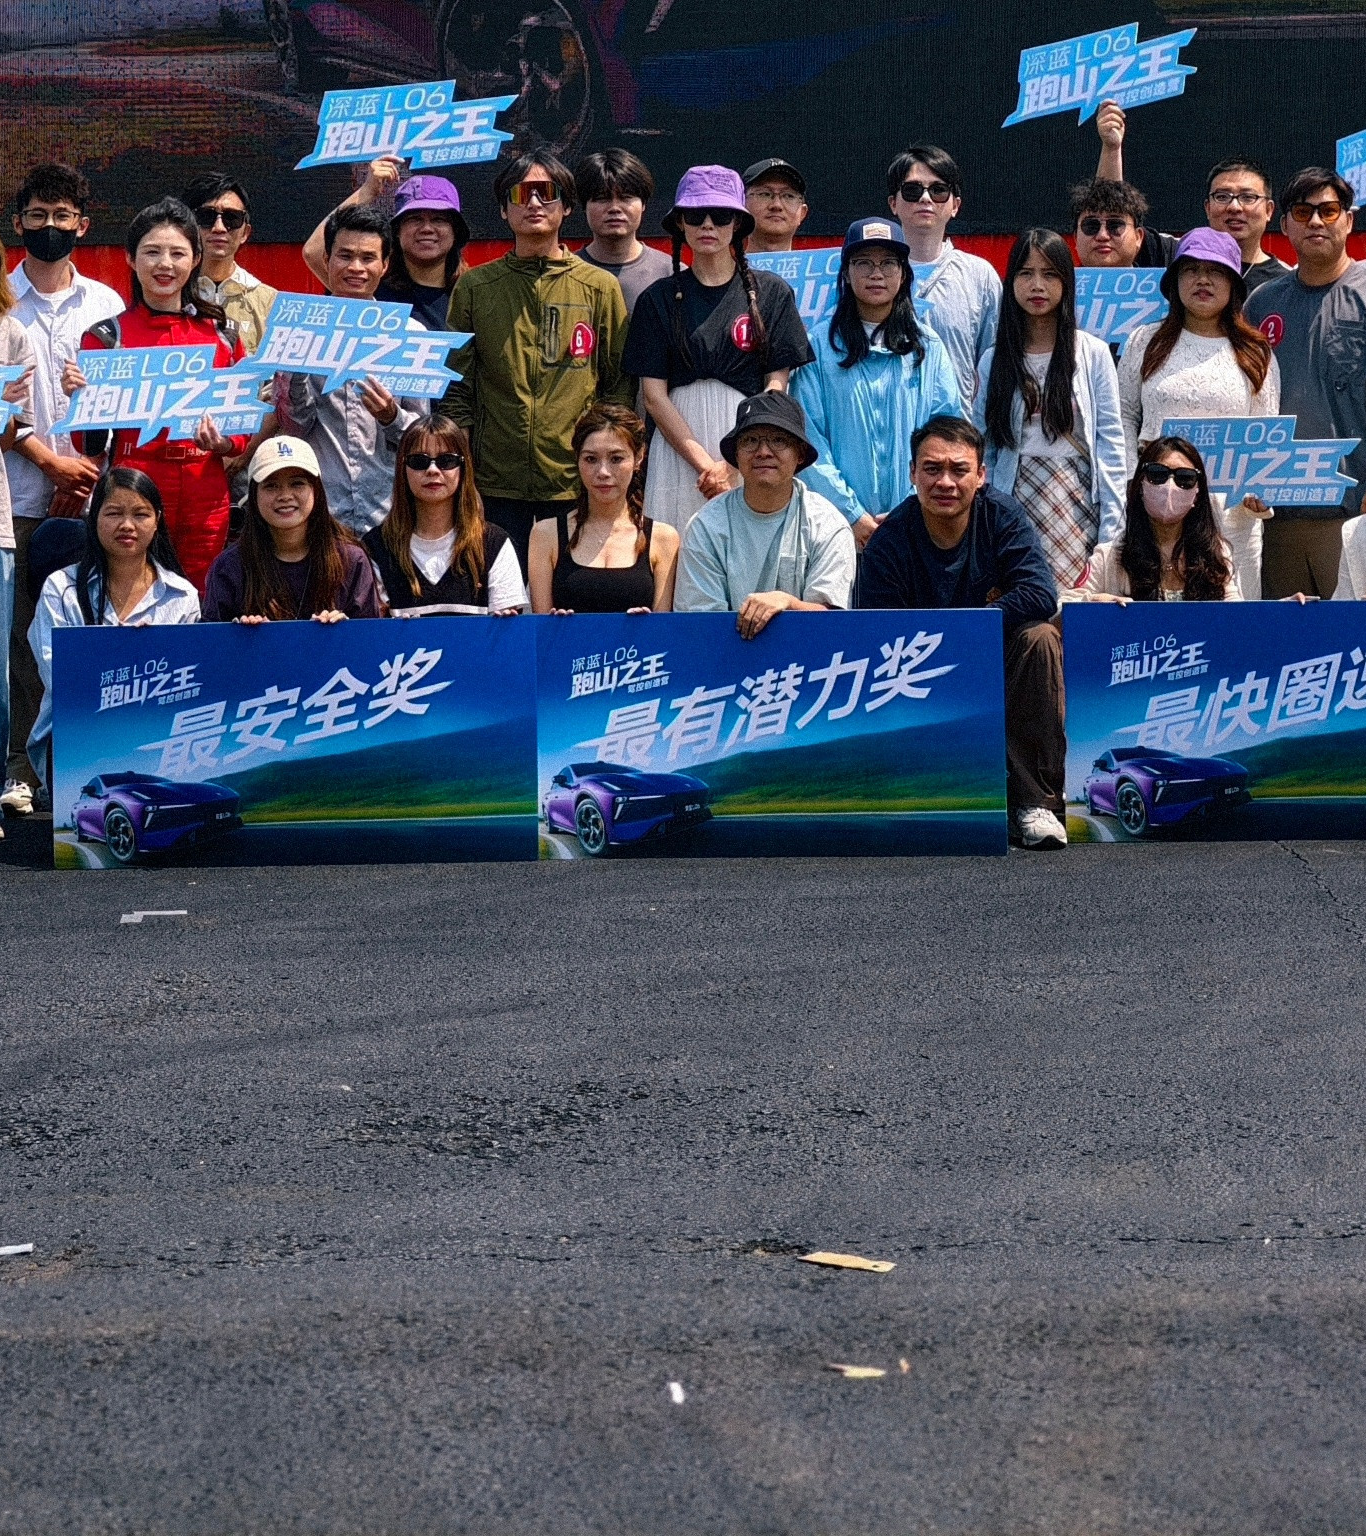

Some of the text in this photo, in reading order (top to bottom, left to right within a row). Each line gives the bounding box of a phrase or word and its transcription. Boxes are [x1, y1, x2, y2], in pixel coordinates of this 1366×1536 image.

[1025, 29, 1131, 78] 深蓝L06
[326, 87, 446, 120] 深蓝L06
[1019, 41, 1186, 119] 跑山之王
[315, 105, 495, 160] 跑山之王
[421, 142, 495, 163] 驾控创造营
[273, 298, 402, 331] 深蓝L06
[84, 351, 207, 381] 深蓝L06
[259, 325, 450, 376] 跑山之王
[67, 373, 263, 428] 跑山之王
[373, 375, 444, 394] 控创造营
[179, 414, 259, 434] 驾创造营
[1202, 447, 1343, 492] 山之王
[1262, 486, 1340, 502] 驾控创造营
[566, 651, 672, 700] 跑山之王
[1106, 641, 1211, 687] 跑山之王
[96, 664, 202, 712] 跑山之王
[575, 630, 958, 768] 最有潜力奖
[137, 648, 453, 777] 最安全奖
